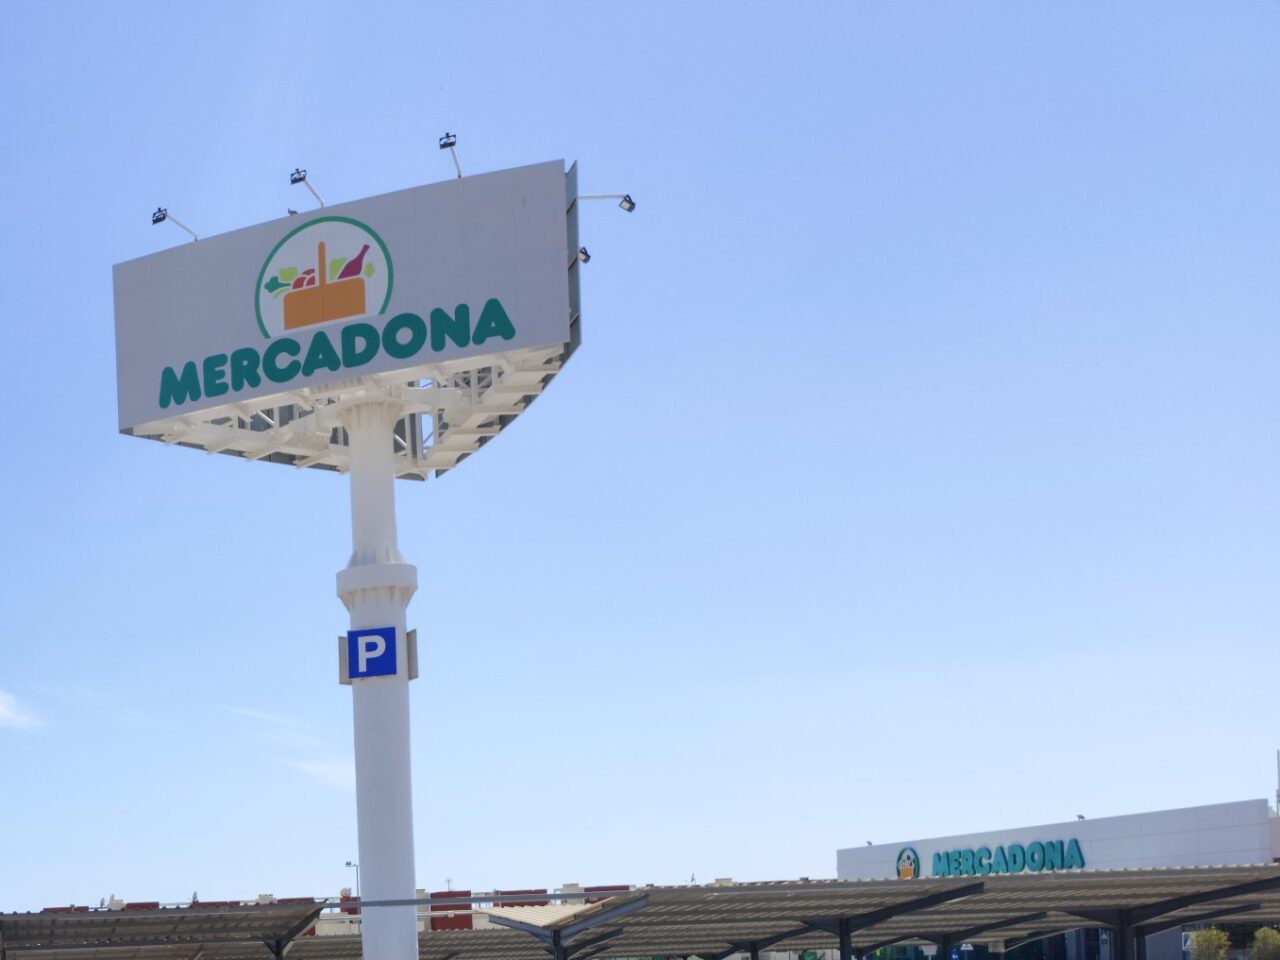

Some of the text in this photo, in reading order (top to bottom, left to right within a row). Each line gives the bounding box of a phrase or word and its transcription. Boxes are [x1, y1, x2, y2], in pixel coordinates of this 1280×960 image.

[159, 298, 516, 409] MERCADONA
[356, 634, 387, 673] P
[932, 838, 1086, 877] MERCADONA
